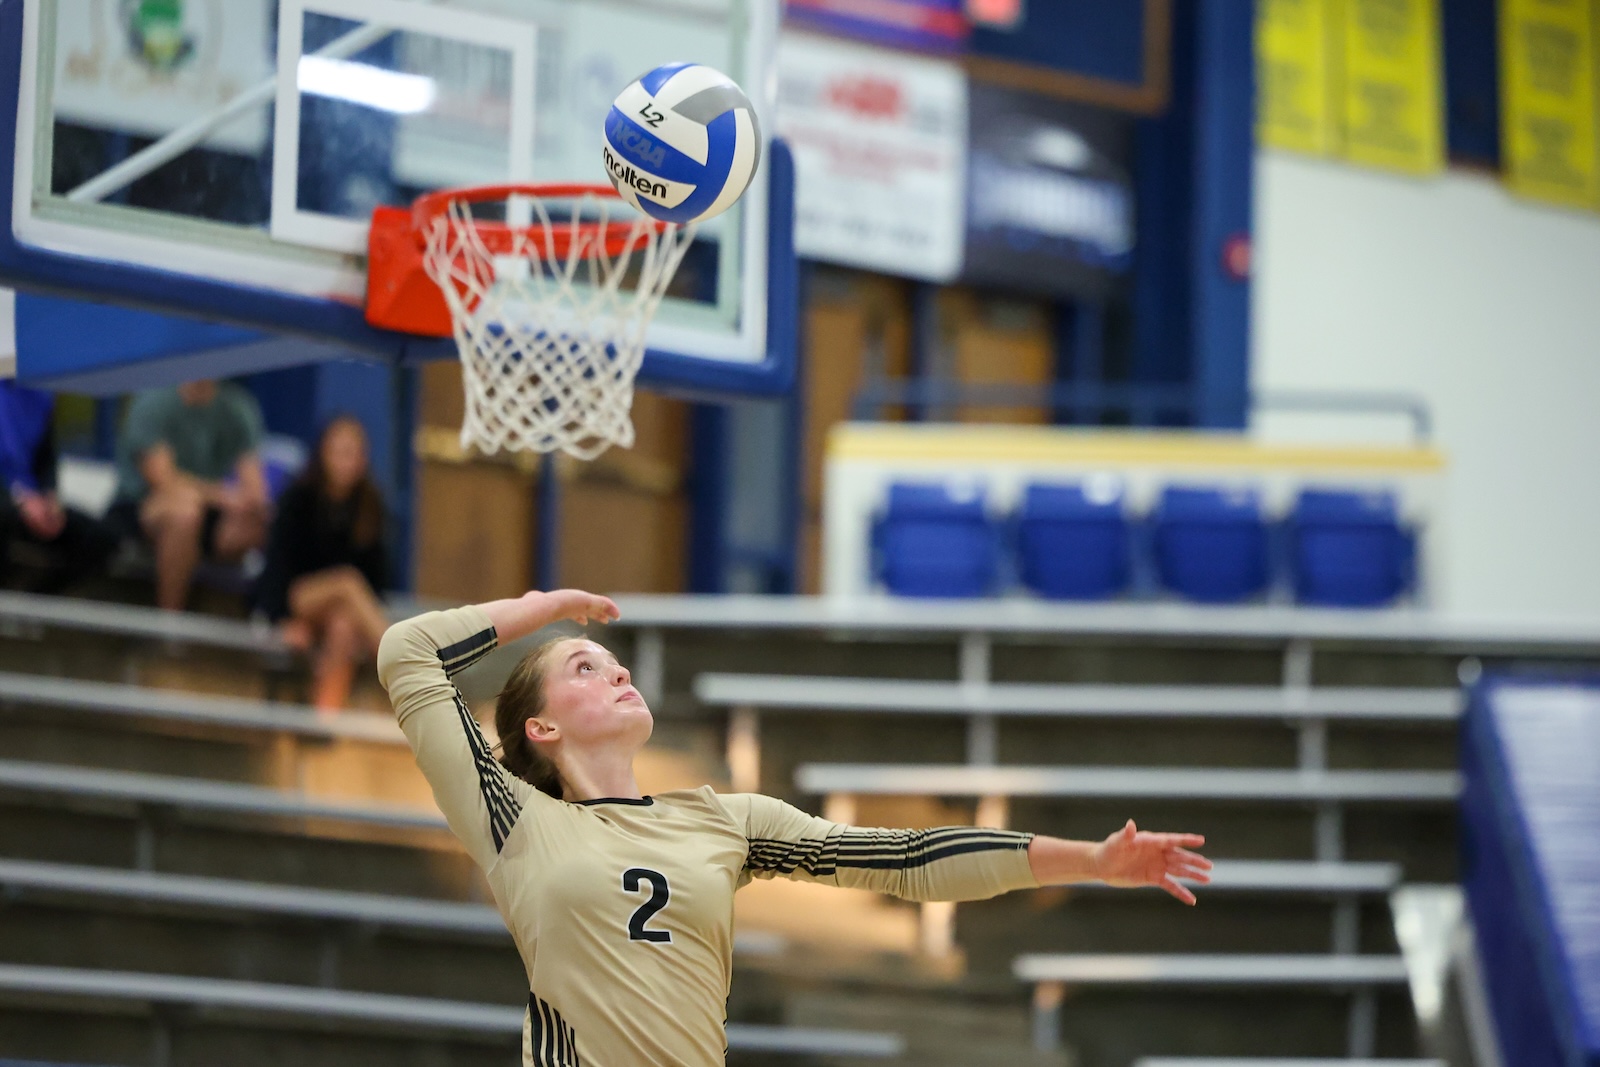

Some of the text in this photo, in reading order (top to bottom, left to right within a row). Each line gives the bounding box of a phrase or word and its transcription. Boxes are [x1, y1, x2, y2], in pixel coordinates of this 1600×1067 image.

[639, 103, 664, 128] L2
[611, 119, 667, 168] NCAA
[604, 147, 667, 198] molten
[621, 866, 673, 944] 2
